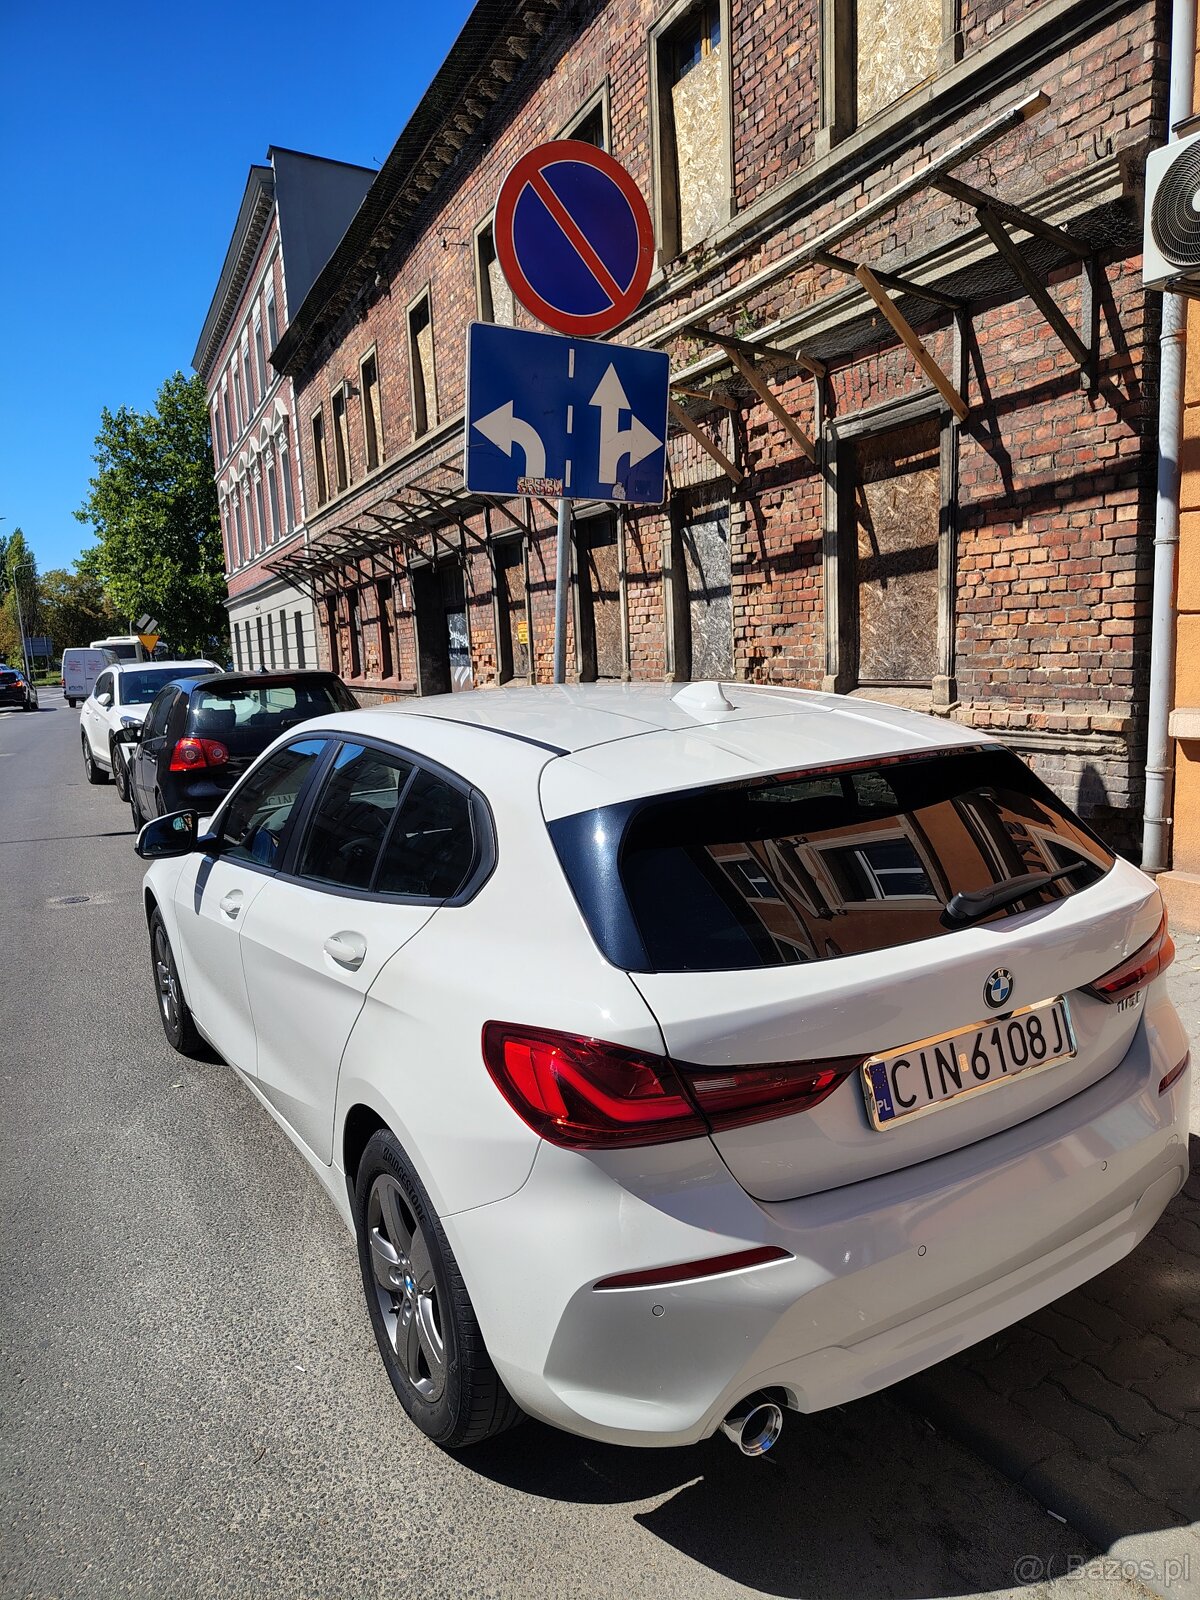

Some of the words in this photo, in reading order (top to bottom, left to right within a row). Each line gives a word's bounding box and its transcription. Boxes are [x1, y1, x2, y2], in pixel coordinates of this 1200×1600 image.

[988, 969, 1013, 986] BMW
[891, 1042, 963, 1108] CIN
[971, 1008, 1063, 1080] 6108J
[877, 1098, 891, 1113] PL
[383, 1146, 427, 1225] BRIDGESTONE
